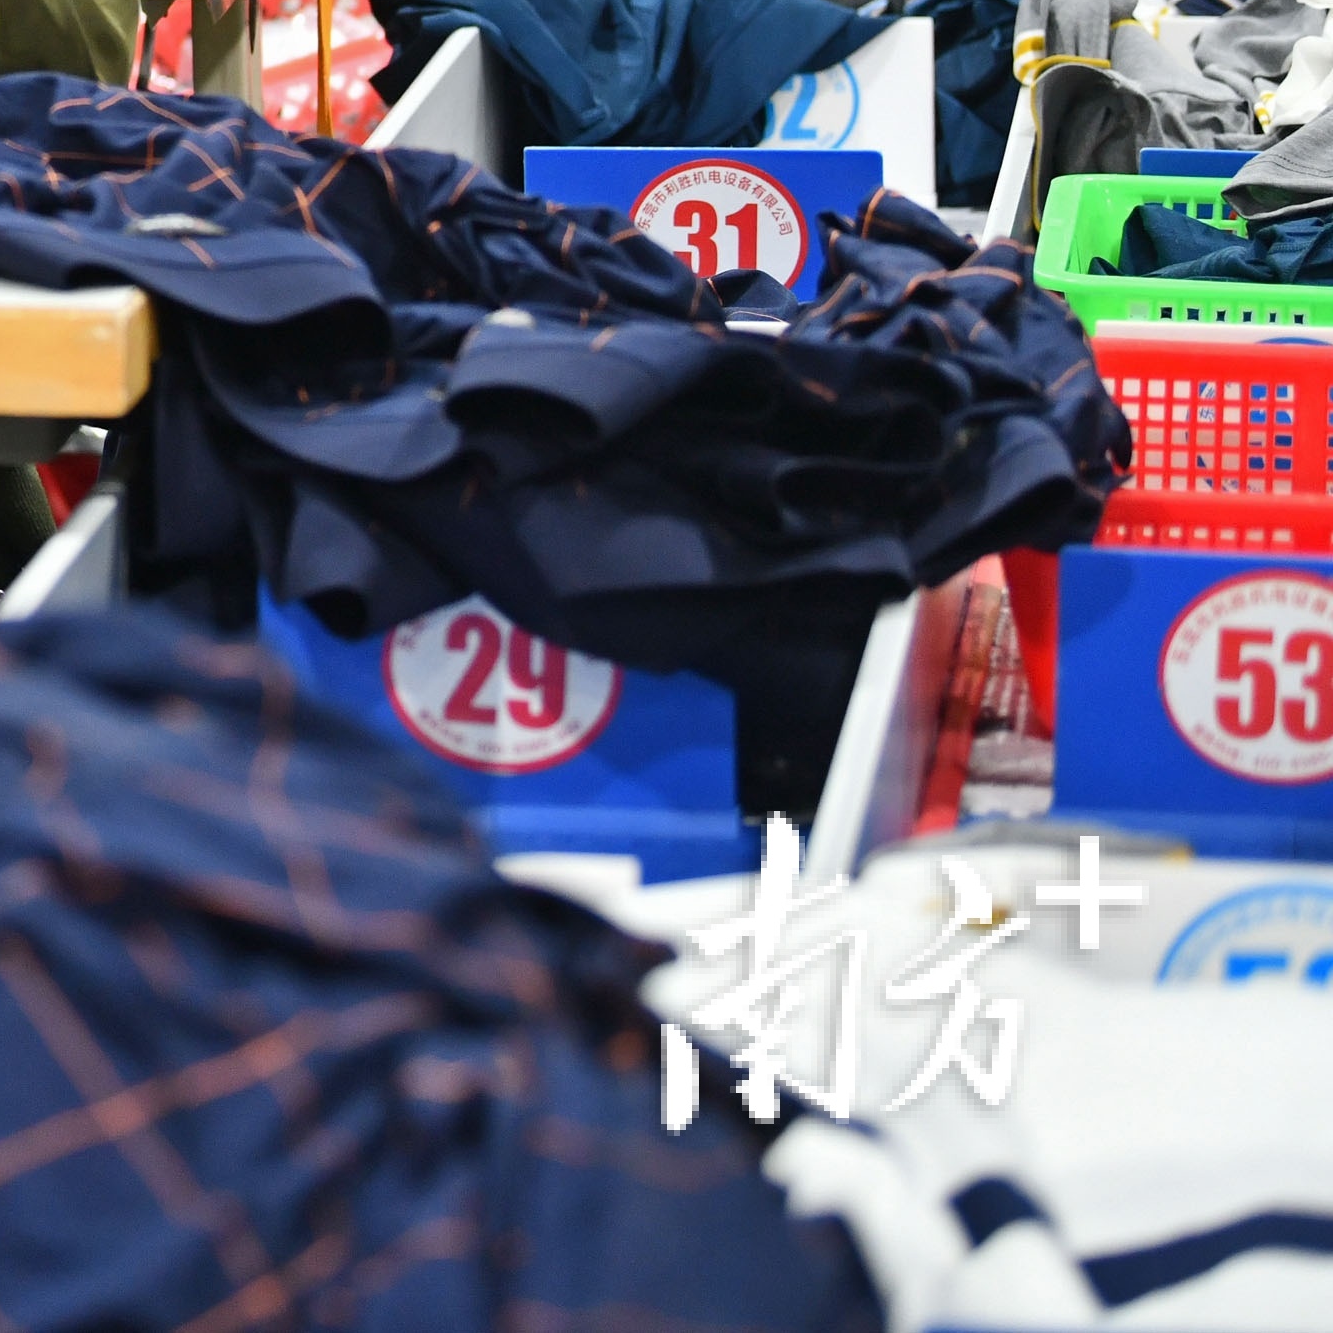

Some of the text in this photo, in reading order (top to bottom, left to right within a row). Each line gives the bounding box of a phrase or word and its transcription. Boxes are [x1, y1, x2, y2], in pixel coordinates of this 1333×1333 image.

[636, 169, 794, 237] 东莞市利胜机电设备有限公司
[673, 199, 759, 279] 31
[443, 611, 568, 730] 29
[1214, 627, 1333, 743] 53
